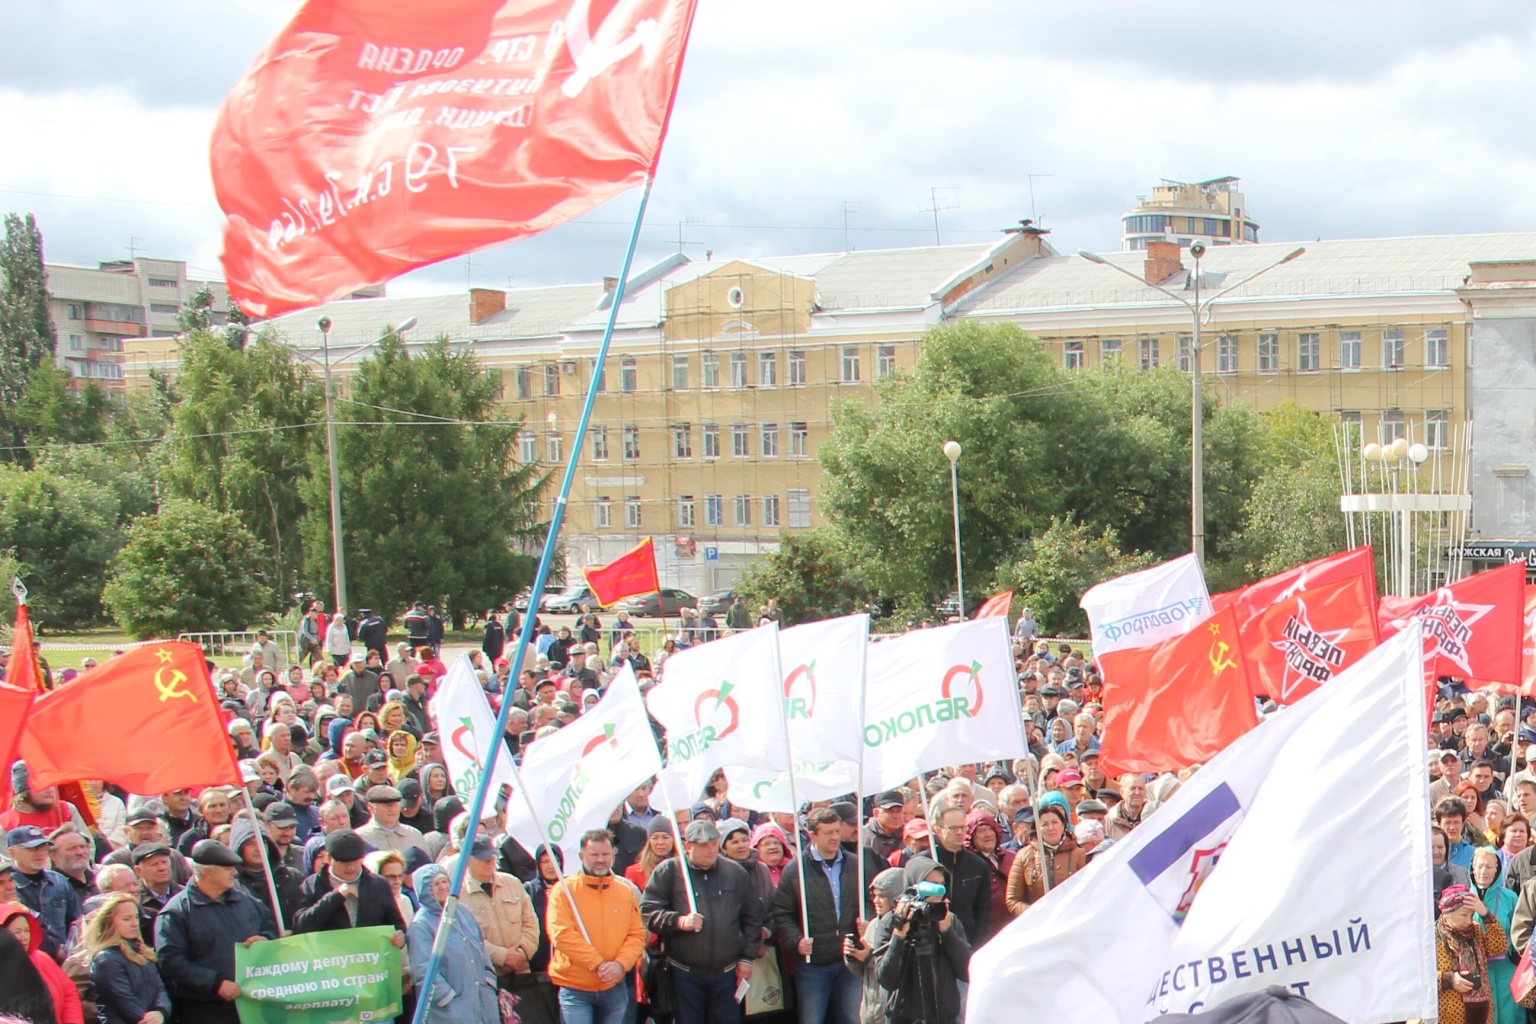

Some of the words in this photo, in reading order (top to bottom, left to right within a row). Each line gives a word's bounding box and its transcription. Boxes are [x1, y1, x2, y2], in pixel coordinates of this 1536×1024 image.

[1448, 547, 1502, 558] МУЖСКАЯ
[245, 958, 310, 979] Каждому
[313, 951, 380, 971] депутату
[250, 981, 318, 1000] среднюю
[321, 977, 340, 991] по
[343, 969, 390, 988] стране
[285, 994, 360, 1011] зарплату!
